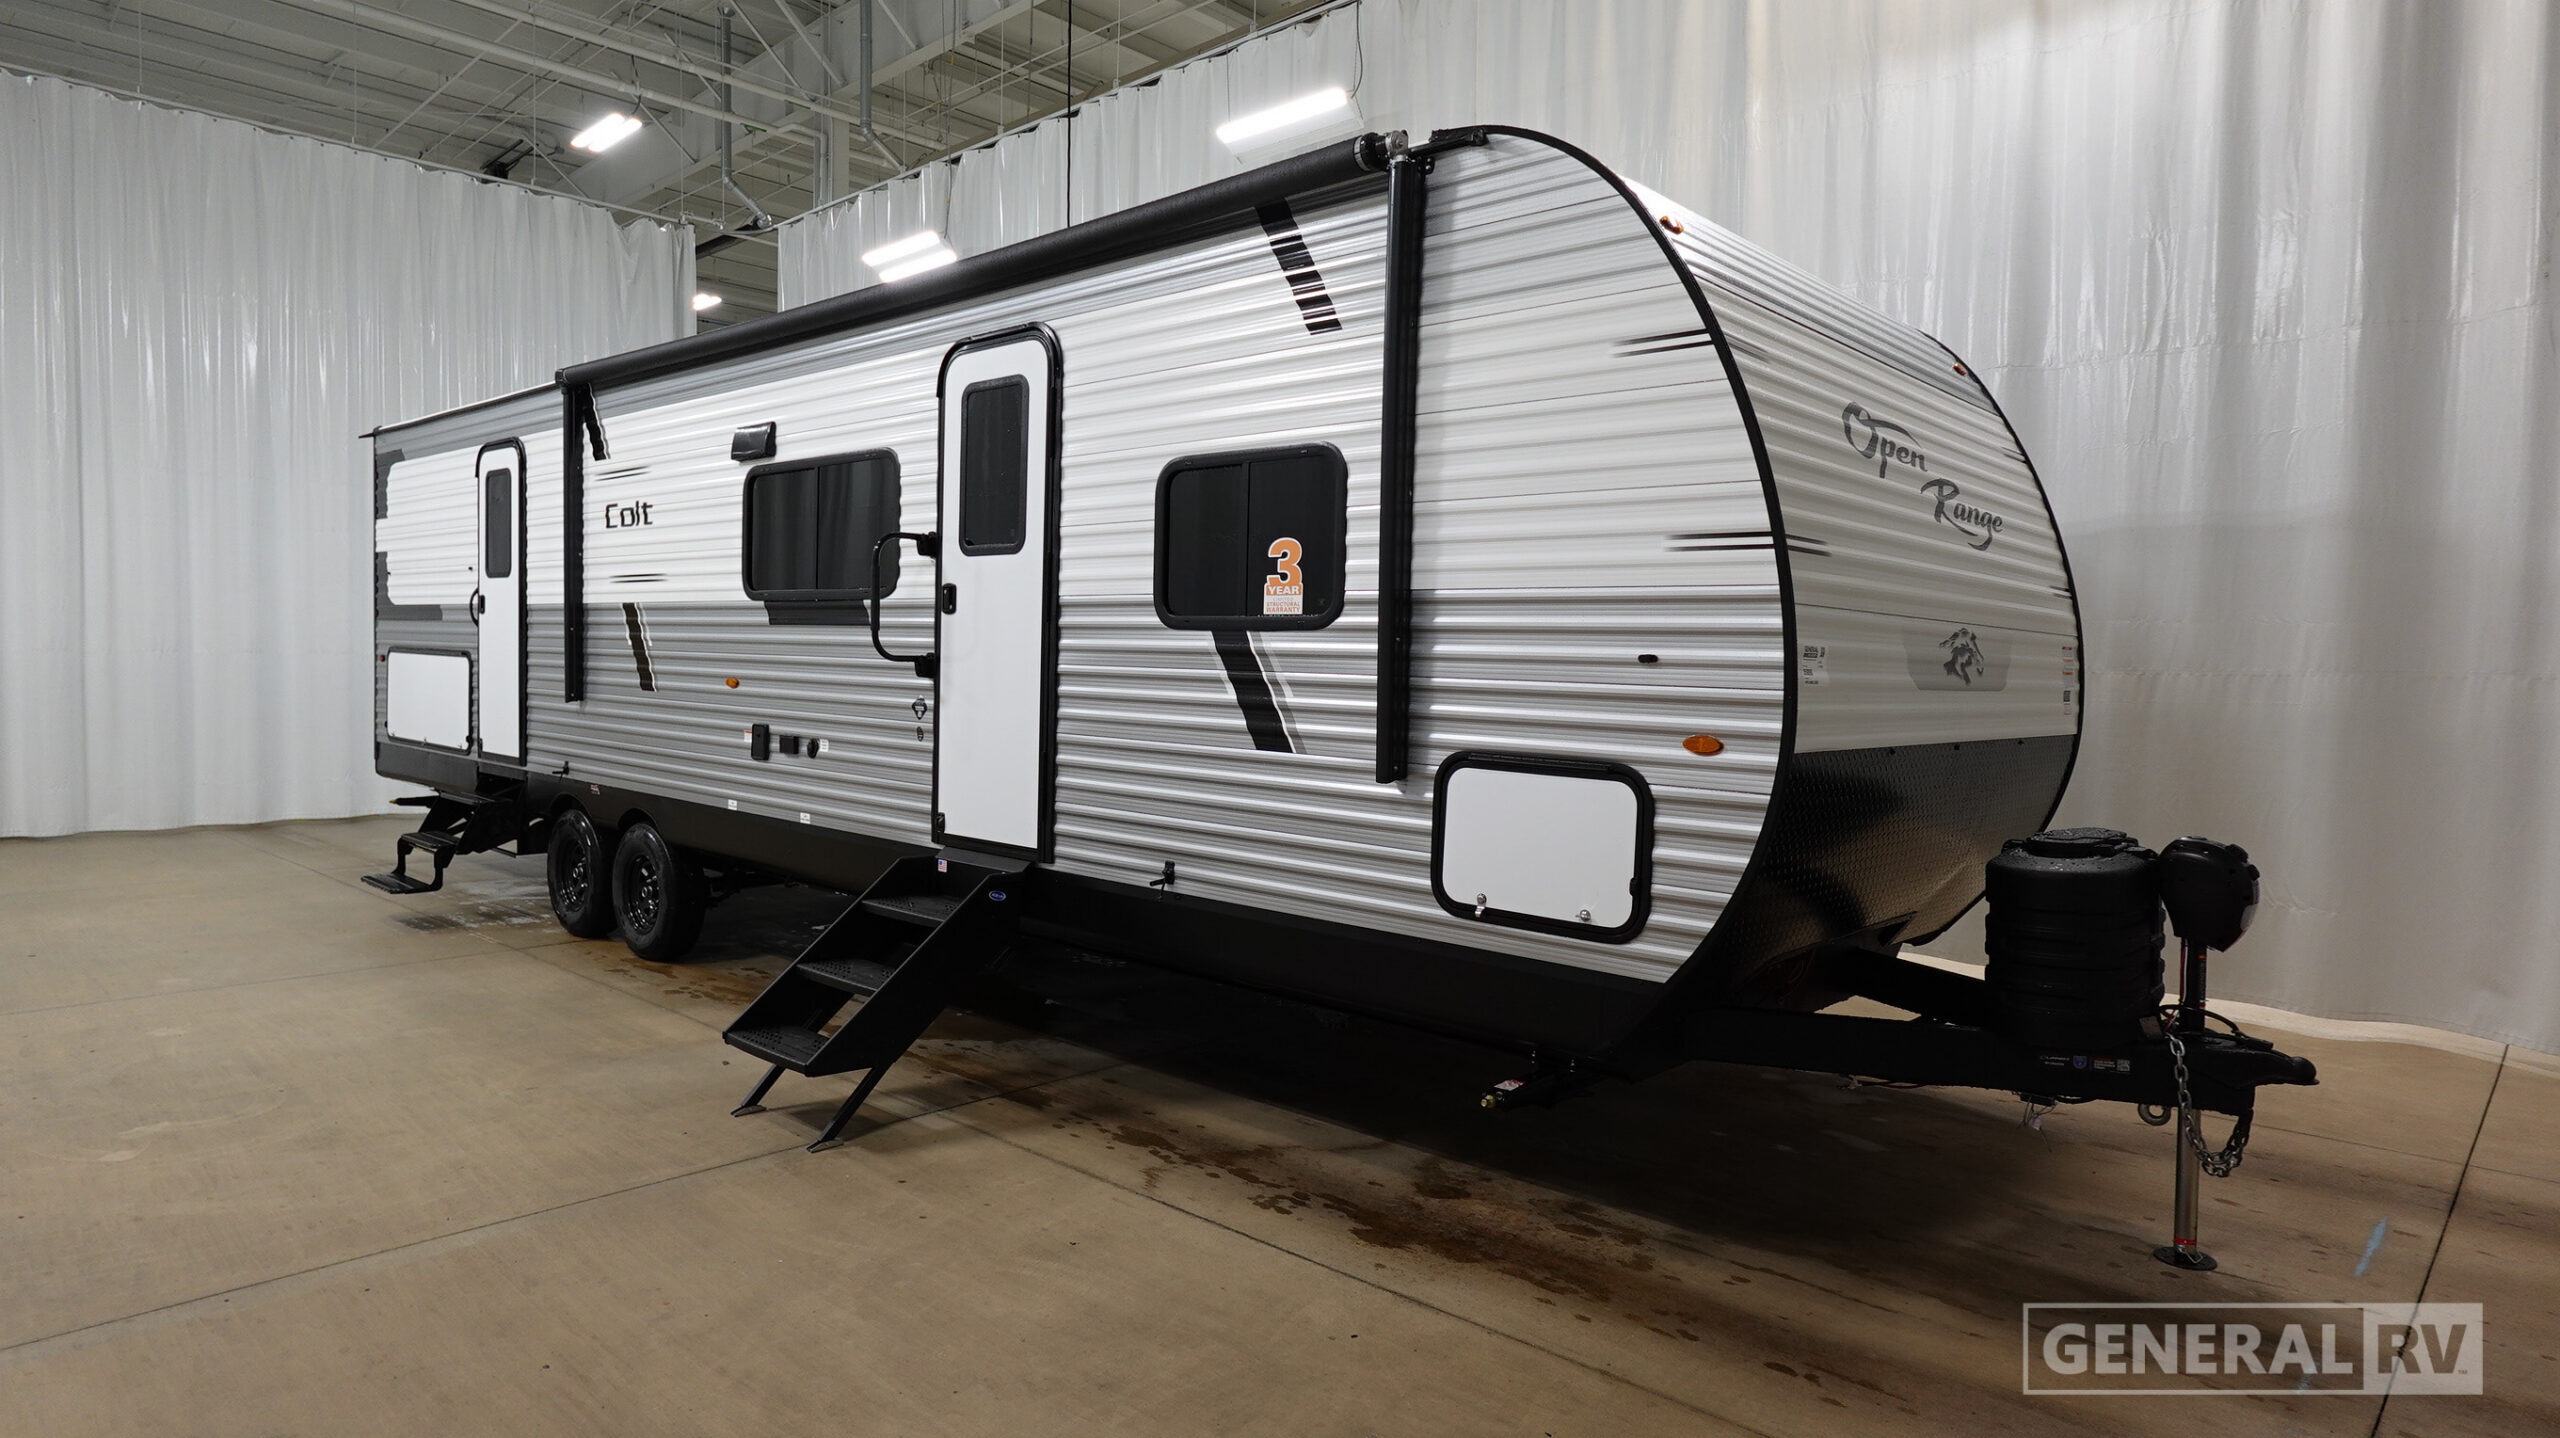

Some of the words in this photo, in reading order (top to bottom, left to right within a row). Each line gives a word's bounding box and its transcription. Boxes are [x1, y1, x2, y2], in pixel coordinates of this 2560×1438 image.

[1842, 402, 1928, 479] Open
[605, 500, 653, 529] Colt
[1921, 478, 2003, 551] Range
[1268, 537, 1303, 586] 3
[1268, 585, 1300, 595] YEAR
